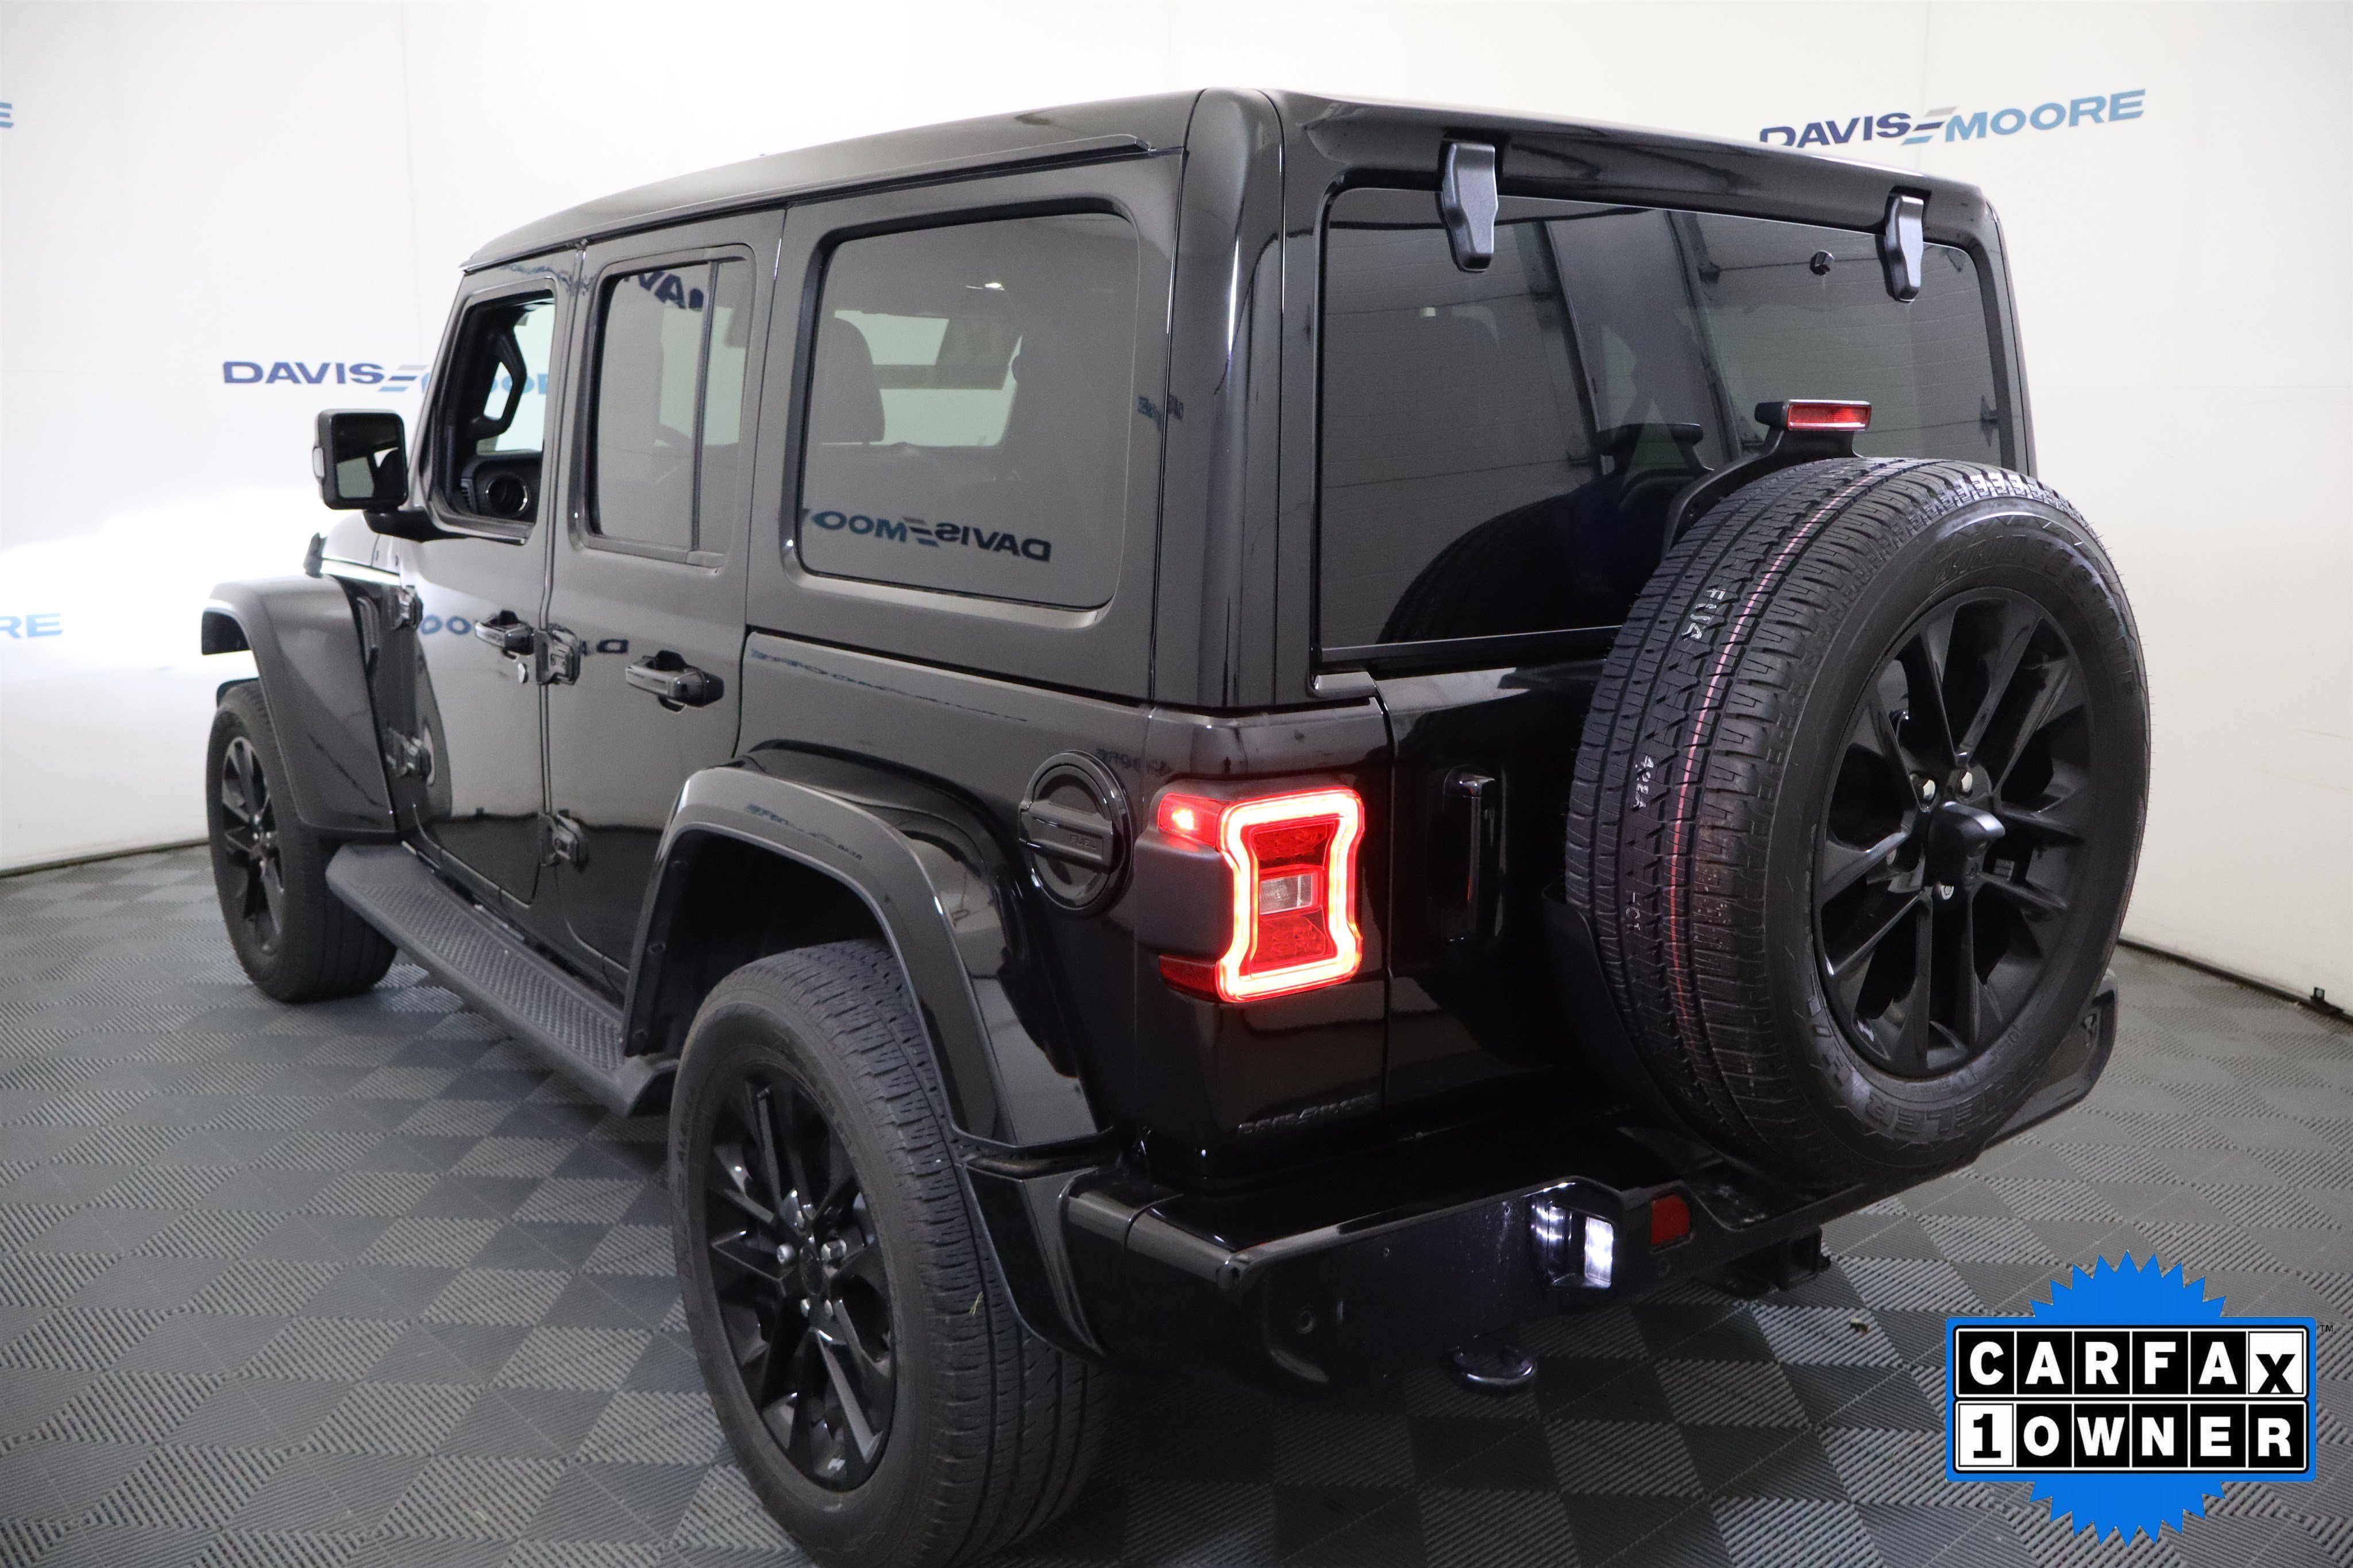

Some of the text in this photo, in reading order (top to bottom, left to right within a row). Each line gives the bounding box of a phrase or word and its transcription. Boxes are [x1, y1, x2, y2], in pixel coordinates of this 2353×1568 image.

[1759, 89, 2146, 148] DAVIS MOORE
[223, 361, 383, 384] DAVIS
[1070, 835, 1097, 849] FUEL
